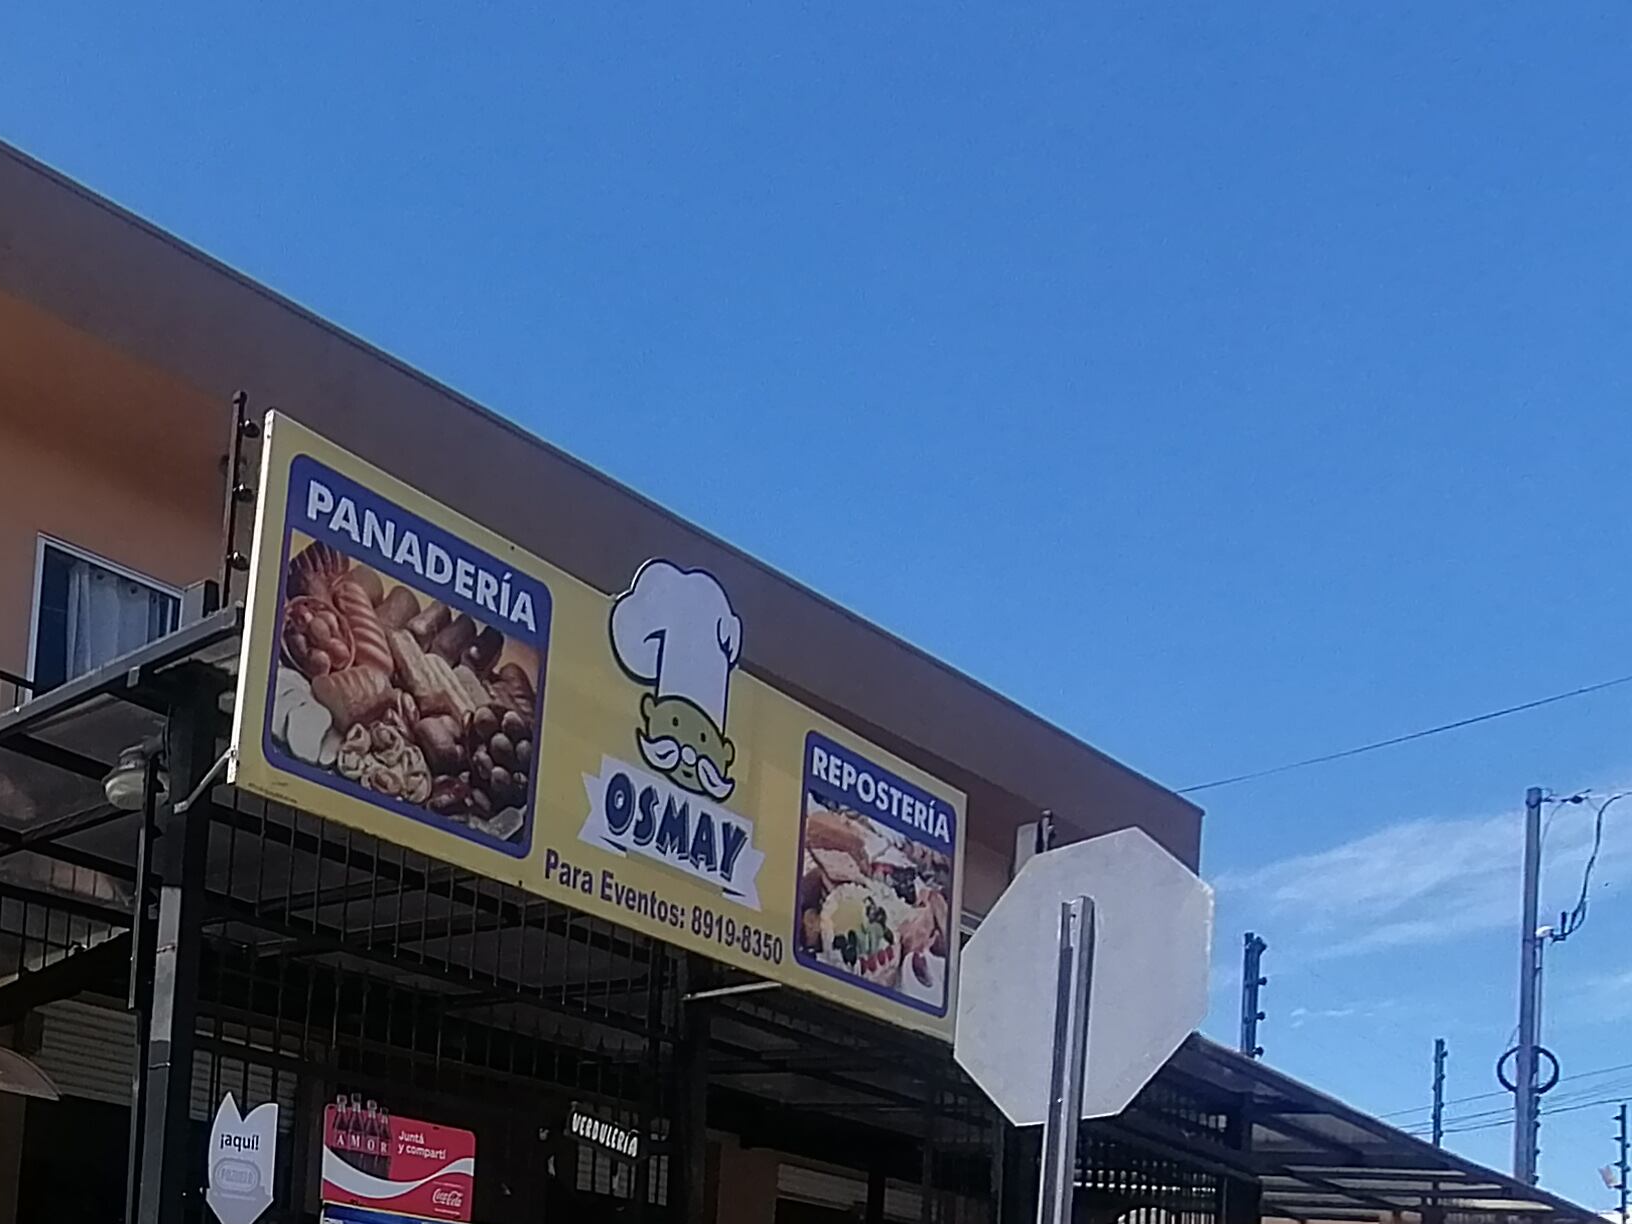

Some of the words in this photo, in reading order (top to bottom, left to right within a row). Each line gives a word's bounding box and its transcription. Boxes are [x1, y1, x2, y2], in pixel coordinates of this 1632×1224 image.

[306, 479, 538, 634] PANADERÍA
[604, 772, 748, 883] OSMAY
[811, 745, 952, 844] REPOSTERÍA
[544, 848, 593, 896] Para
[599, 871, 686, 929] Eventos:
[690, 906, 784, 966] 8919-8350
[220, 1134, 259, 1153] ¡aquí!
